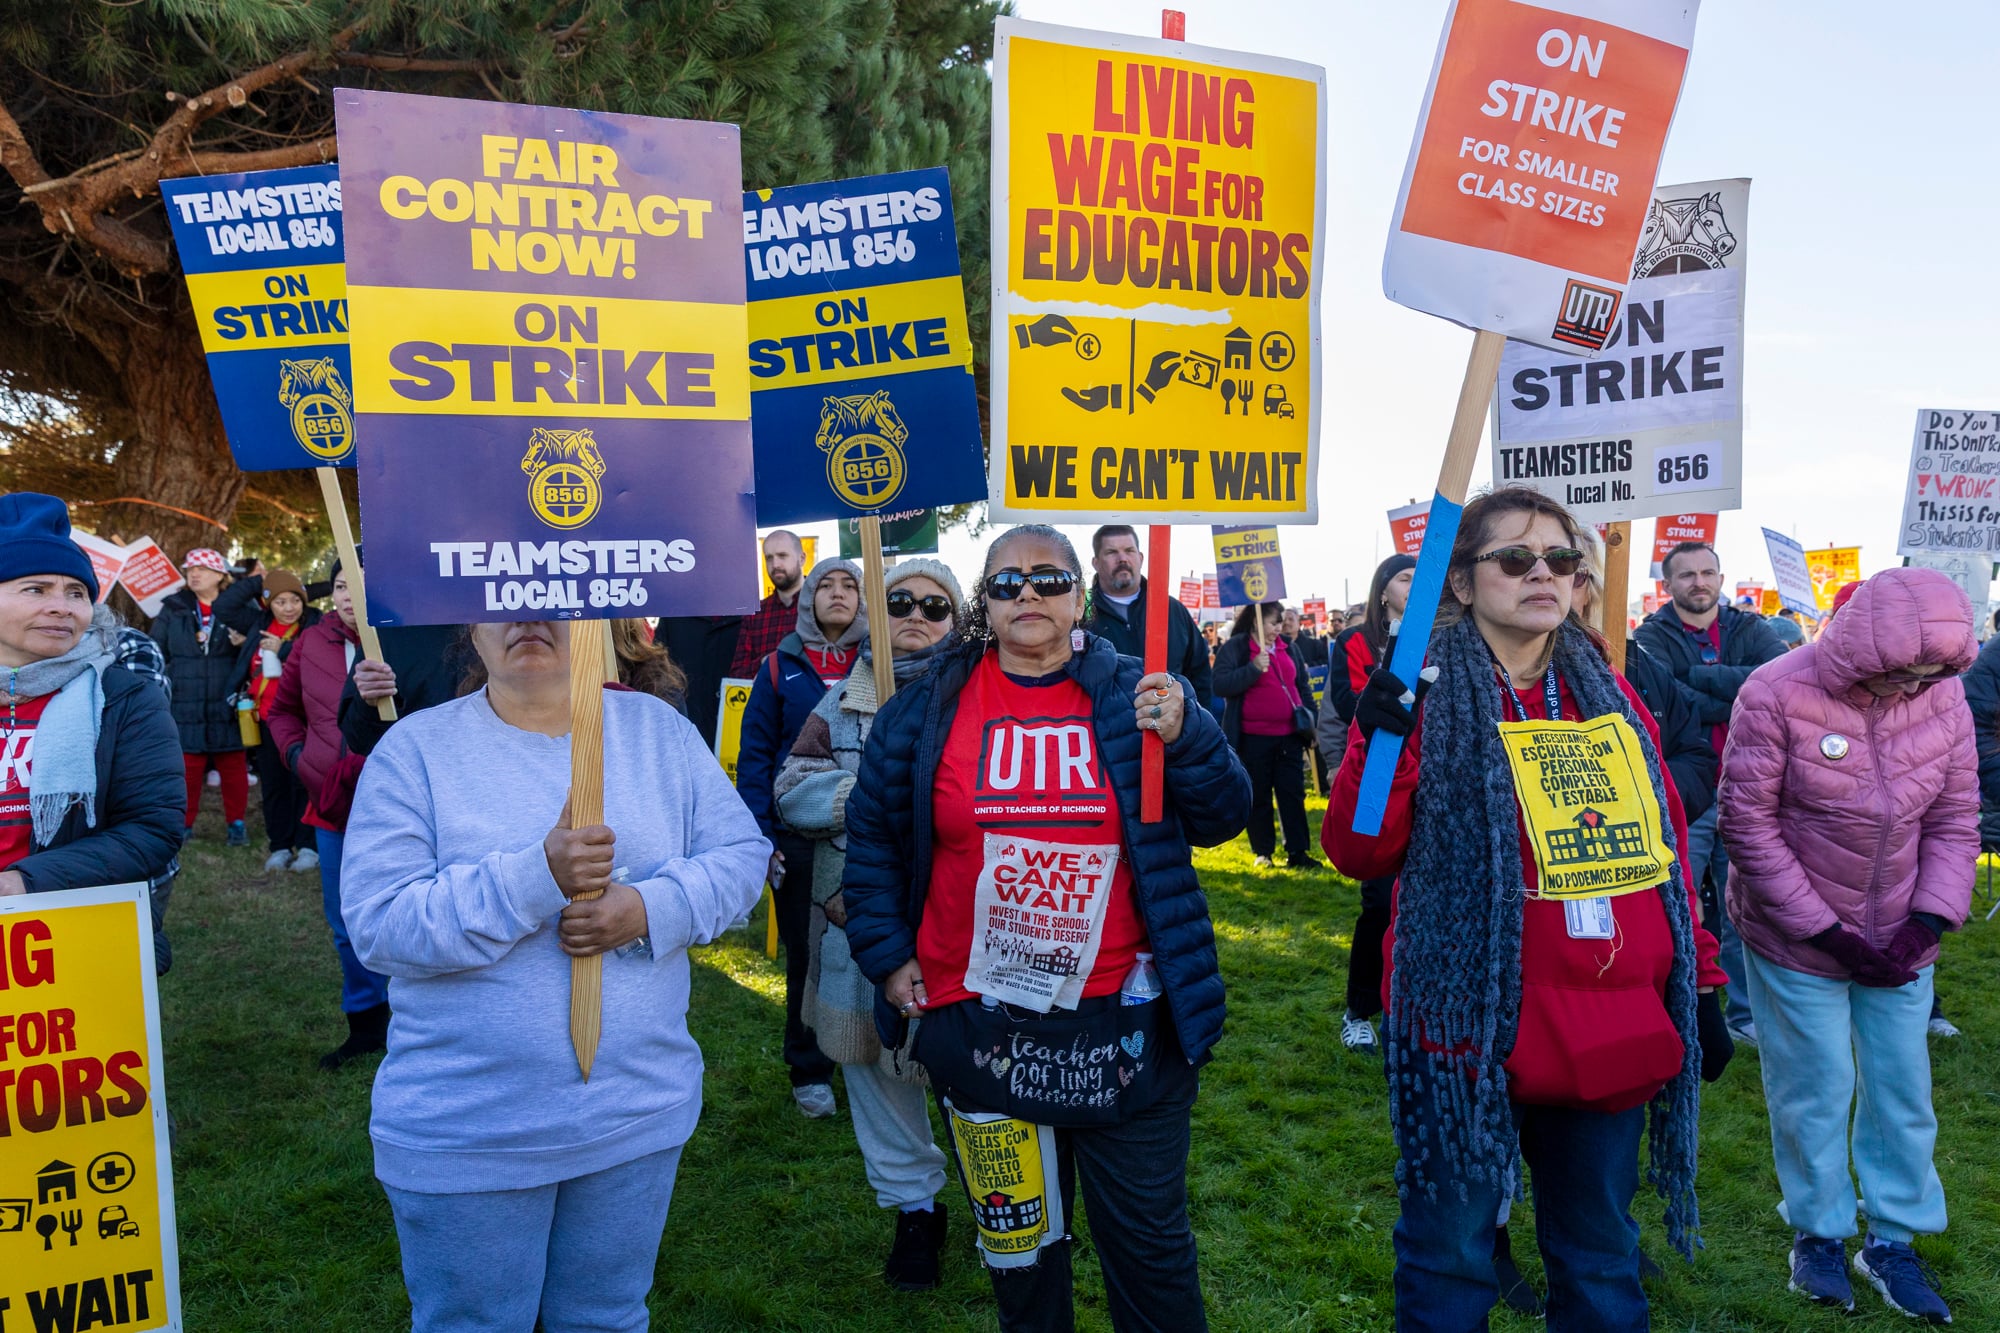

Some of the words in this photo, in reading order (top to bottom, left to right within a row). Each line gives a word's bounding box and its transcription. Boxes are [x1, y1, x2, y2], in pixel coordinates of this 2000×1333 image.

[1535, 28, 1608, 79] ON
[1093, 59, 1255, 150] LIVING
[1479, 79, 1626, 148] STRIKE
[481, 135, 620, 187] FAIR
[1459, 136, 1509, 168] FOR
[1513, 149, 1619, 197] SMALLER
[1046, 132, 1201, 218] WAGE
[1204, 170, 1264, 222] FOR
[172, 180, 343, 224] TEAMSTERS
[379, 175, 712, 239] CONTRACT
[1457, 172, 1537, 209] CLASS
[1540, 190, 1607, 228] SIZES
[743, 187, 942, 244] EAMSTERS
[206, 221, 290, 256] LOCAL
[288, 217, 336, 249] 856
[470, 228, 637, 280] NOW!
[749, 237, 850, 281] LOCAL
[853, 229, 916, 267] 856
[1022, 208, 1310, 300] EDUCATORS
[1649, 245, 1714, 266] BROTHERHOOD
[264, 274, 310, 298] ON
[213, 298, 350, 340] STRIK
[513, 303, 599, 344] ON
[815, 296, 869, 327] ON
[1565, 285, 1615, 332] UTR
[748, 317, 950, 378] STRIKE
[388, 341, 717, 408] STRIKE
[1511, 346, 1725, 412] STRIKE
[305, 417, 343, 435] 856
[1929, 411, 1954, 429] Do
[1959, 412, 1987, 431] You
[1922, 430, 1959, 450] This
[845, 459, 889, 481] 856
[1010, 444, 1078, 499] WE
[1090, 446, 1199, 500] CAN'T
[1210, 450, 1301, 502] WAIT
[1500, 439, 1633, 480] TEAMSTERS
[1657, 453, 1709, 484] 856
[545, 487, 586, 503] 856
[1566, 483, 1607, 505] Local
[1610, 480, 1635, 502] No.
[1934, 473, 1996, 498] WRONG
[1408, 516, 1426, 528] ON
[1677, 515, 1697, 525] ON
[1918, 500, 1957, 522] This
[1959, 504, 1974, 522] is
[1243, 532, 1259, 542] ON
[1403, 529, 1426, 542] STRI
[1666, 527, 1705, 538] STRIKE
[430, 538, 696, 578] TEAMSTERS
[1220, 540, 1277, 558] STRIKE
[485, 579, 584, 611] LOCAL
[588, 578, 648, 609] 856
[1520, 744, 1583, 762] ESCUELAS
[1586, 740, 1614, 758] CON
[1532, 733, 1592, 745] NECESITAMOS
[988, 724, 1097, 791] UTR
[1540, 758, 1606, 776] PERSONAL
[1540, 773, 1611, 793] COMPLETO
[1547, 793, 1557, 808] Y
[1561, 786, 1618, 807] ESTABLE
[974, 806, 1004, 814] UNITED
[1005, 806, 1047, 814] TEACHERS
[1062, 805, 1106, 814] RICHMOND
[1021, 847, 1082, 873] WE
[993, 864, 1102, 894] CAN'T
[1547, 871, 1563, 889] NO
[1565, 868, 1613, 888] PODEMOS
[994, 883, 1093, 914] WAIT
[988, 916, 1006, 931] OUR
[1008, 921, 1052, 941] STUDENTS
[989, 905, 1019, 920] INVEST
[1021, 911, 1031, 923] IN
[1033, 913, 1049, 927] THE
[1052, 916, 1090, 930] SCHOOLS
[990, 977, 1005, 985] LIVING
[1005, 1127, 1030, 1145] CON
[976, 1170, 1025, 1189] ESTABLE
[25, 1268, 153, 1333] WAIT
